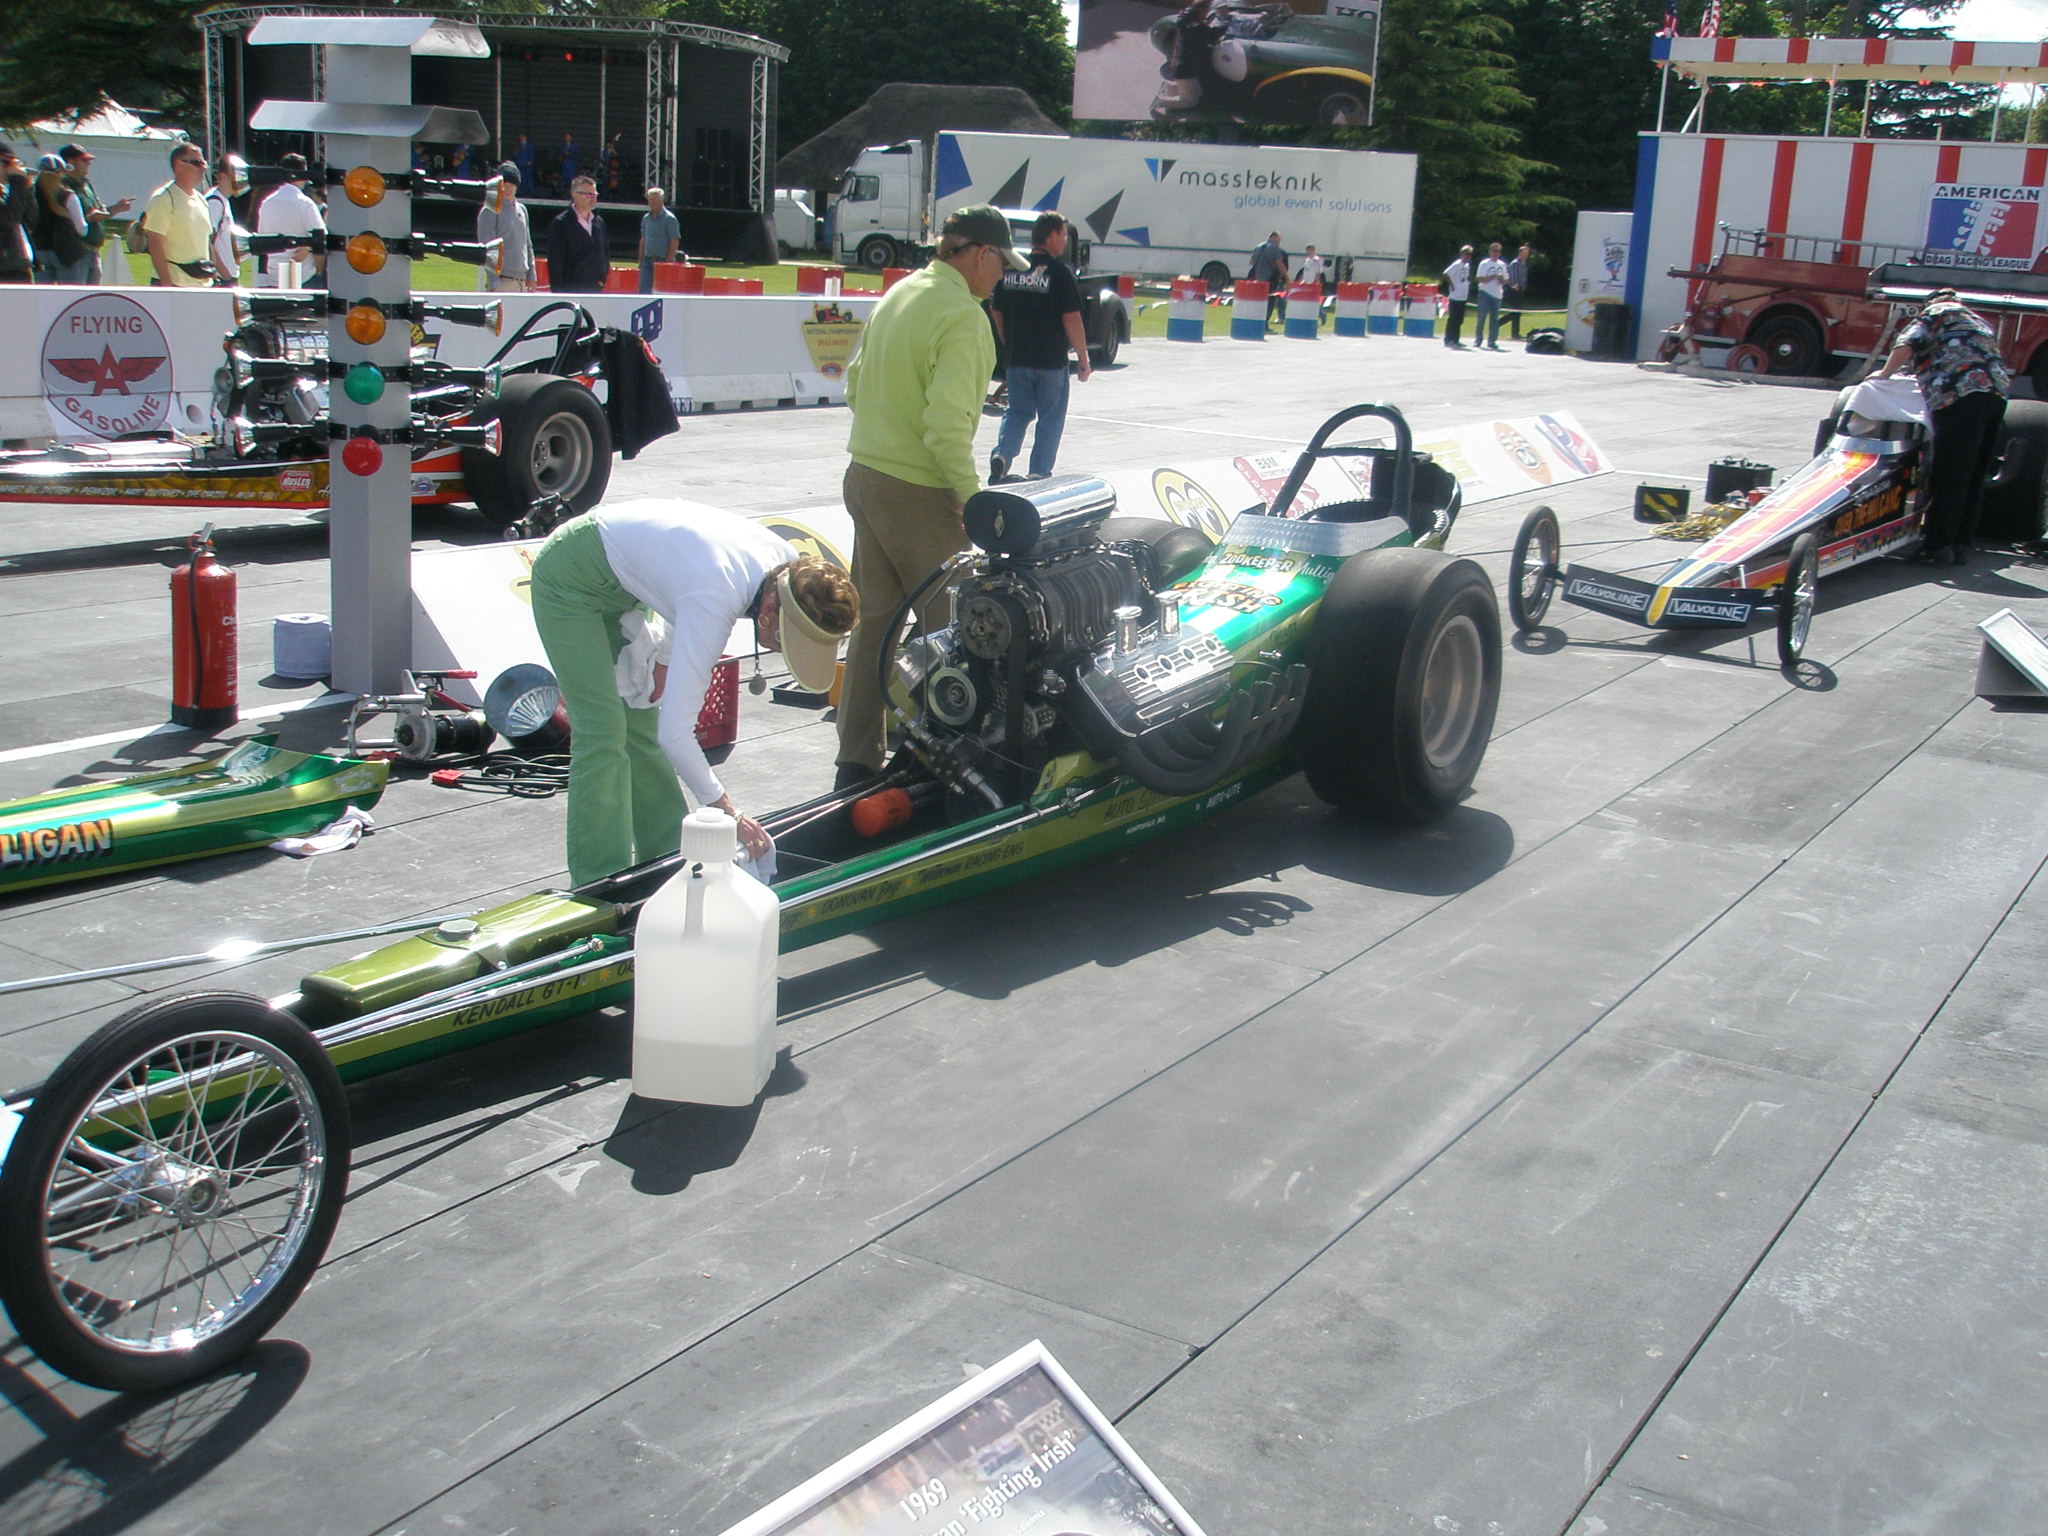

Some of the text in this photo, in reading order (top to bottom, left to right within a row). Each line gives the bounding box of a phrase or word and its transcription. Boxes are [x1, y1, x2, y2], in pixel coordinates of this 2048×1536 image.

[1180, 169, 1323, 191] massteknik
[1234, 194, 1393, 213] global event solutions
[1935, 186, 2040, 200] AMERICAN
[1992, 258, 2030, 269] LEAGUE
[1004, 272, 1049, 288] HILBORN
[71, 316, 143, 334] FLYING
[65, 394, 160, 433] GASOLINE
[1220, 552, 1296, 572] ZOOKEEPER
[1298, 561, 1337, 584] Mullig
[1172, 580, 1284, 606] FIGHTING
[1575, 580, 1645, 608] VALVOLINE
[1673, 600, 1746, 620] VALVOLINE
[1103, 797, 1135, 819] AUTO
[822, 885, 875, 914] DONOVAN
[453, 988, 536, 1027] KENDALL
[900, 1477, 949, 1522] 1969
